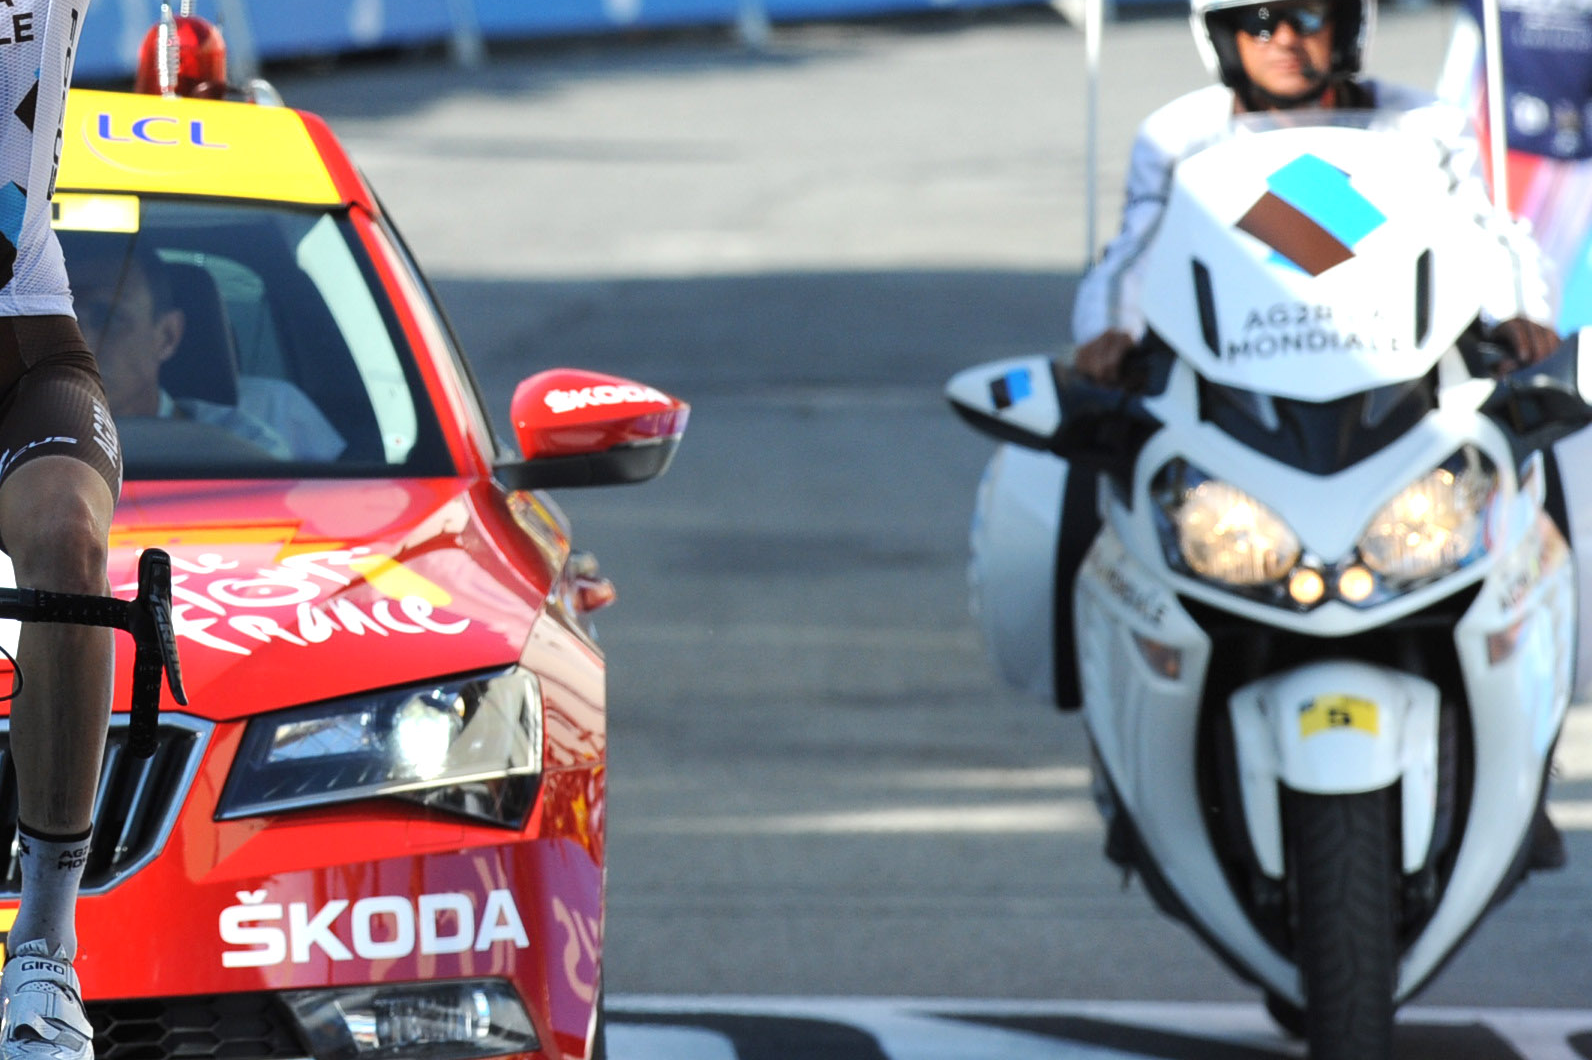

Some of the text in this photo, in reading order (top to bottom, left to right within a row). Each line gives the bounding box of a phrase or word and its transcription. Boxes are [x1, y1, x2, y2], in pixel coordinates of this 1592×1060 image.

[98, 114, 228, 149] LCL
[219, 889, 530, 968] ŠKODA
[21, 960, 65, 976] GIRO
